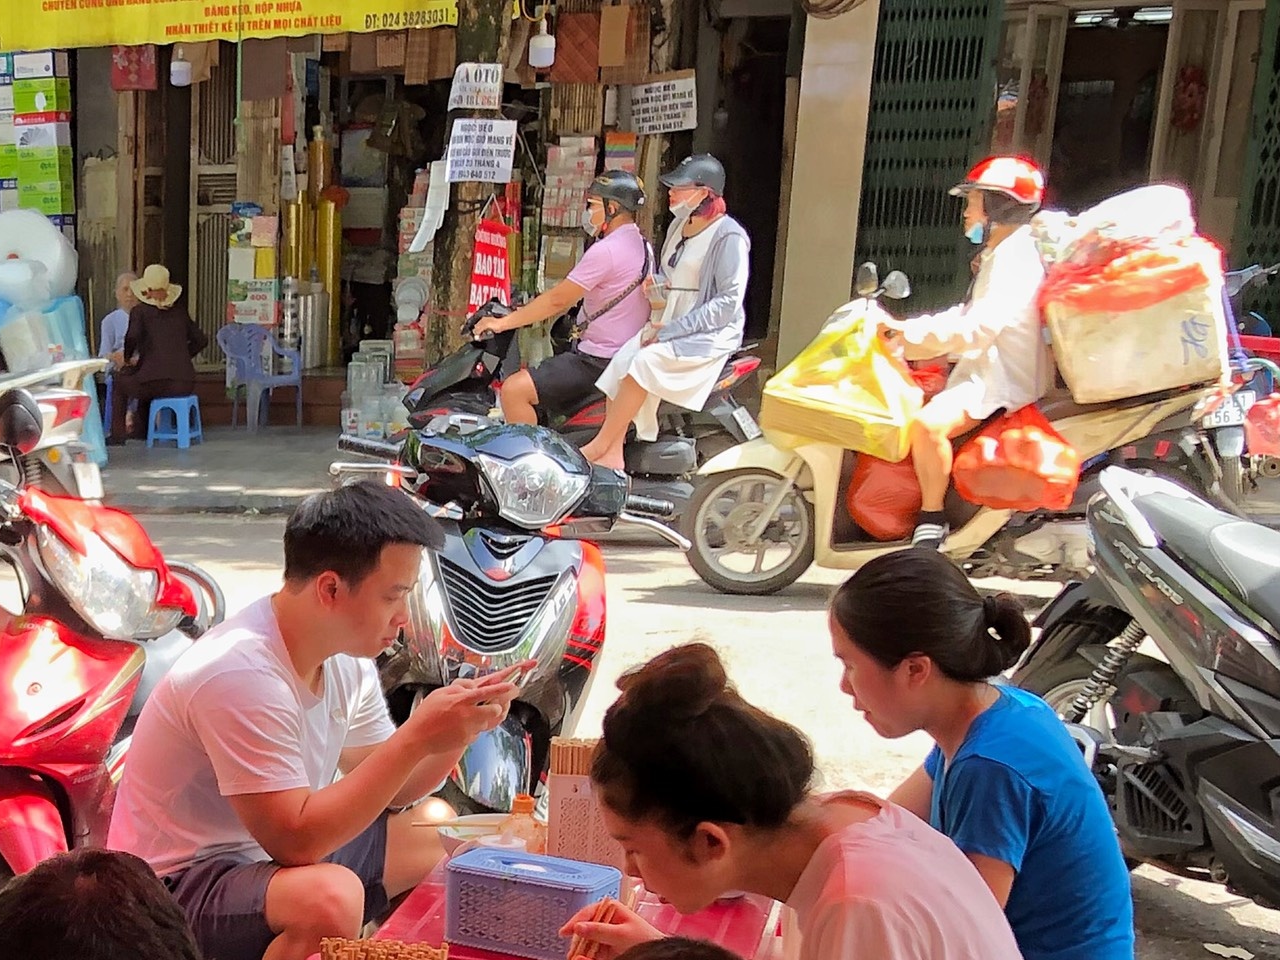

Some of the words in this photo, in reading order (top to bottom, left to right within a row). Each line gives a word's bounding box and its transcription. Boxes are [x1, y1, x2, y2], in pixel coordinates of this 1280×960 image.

[382, 13, 400, 28] 024
[402, 7, 450, 26] 38283031
[475, 252, 492, 276] BAO
